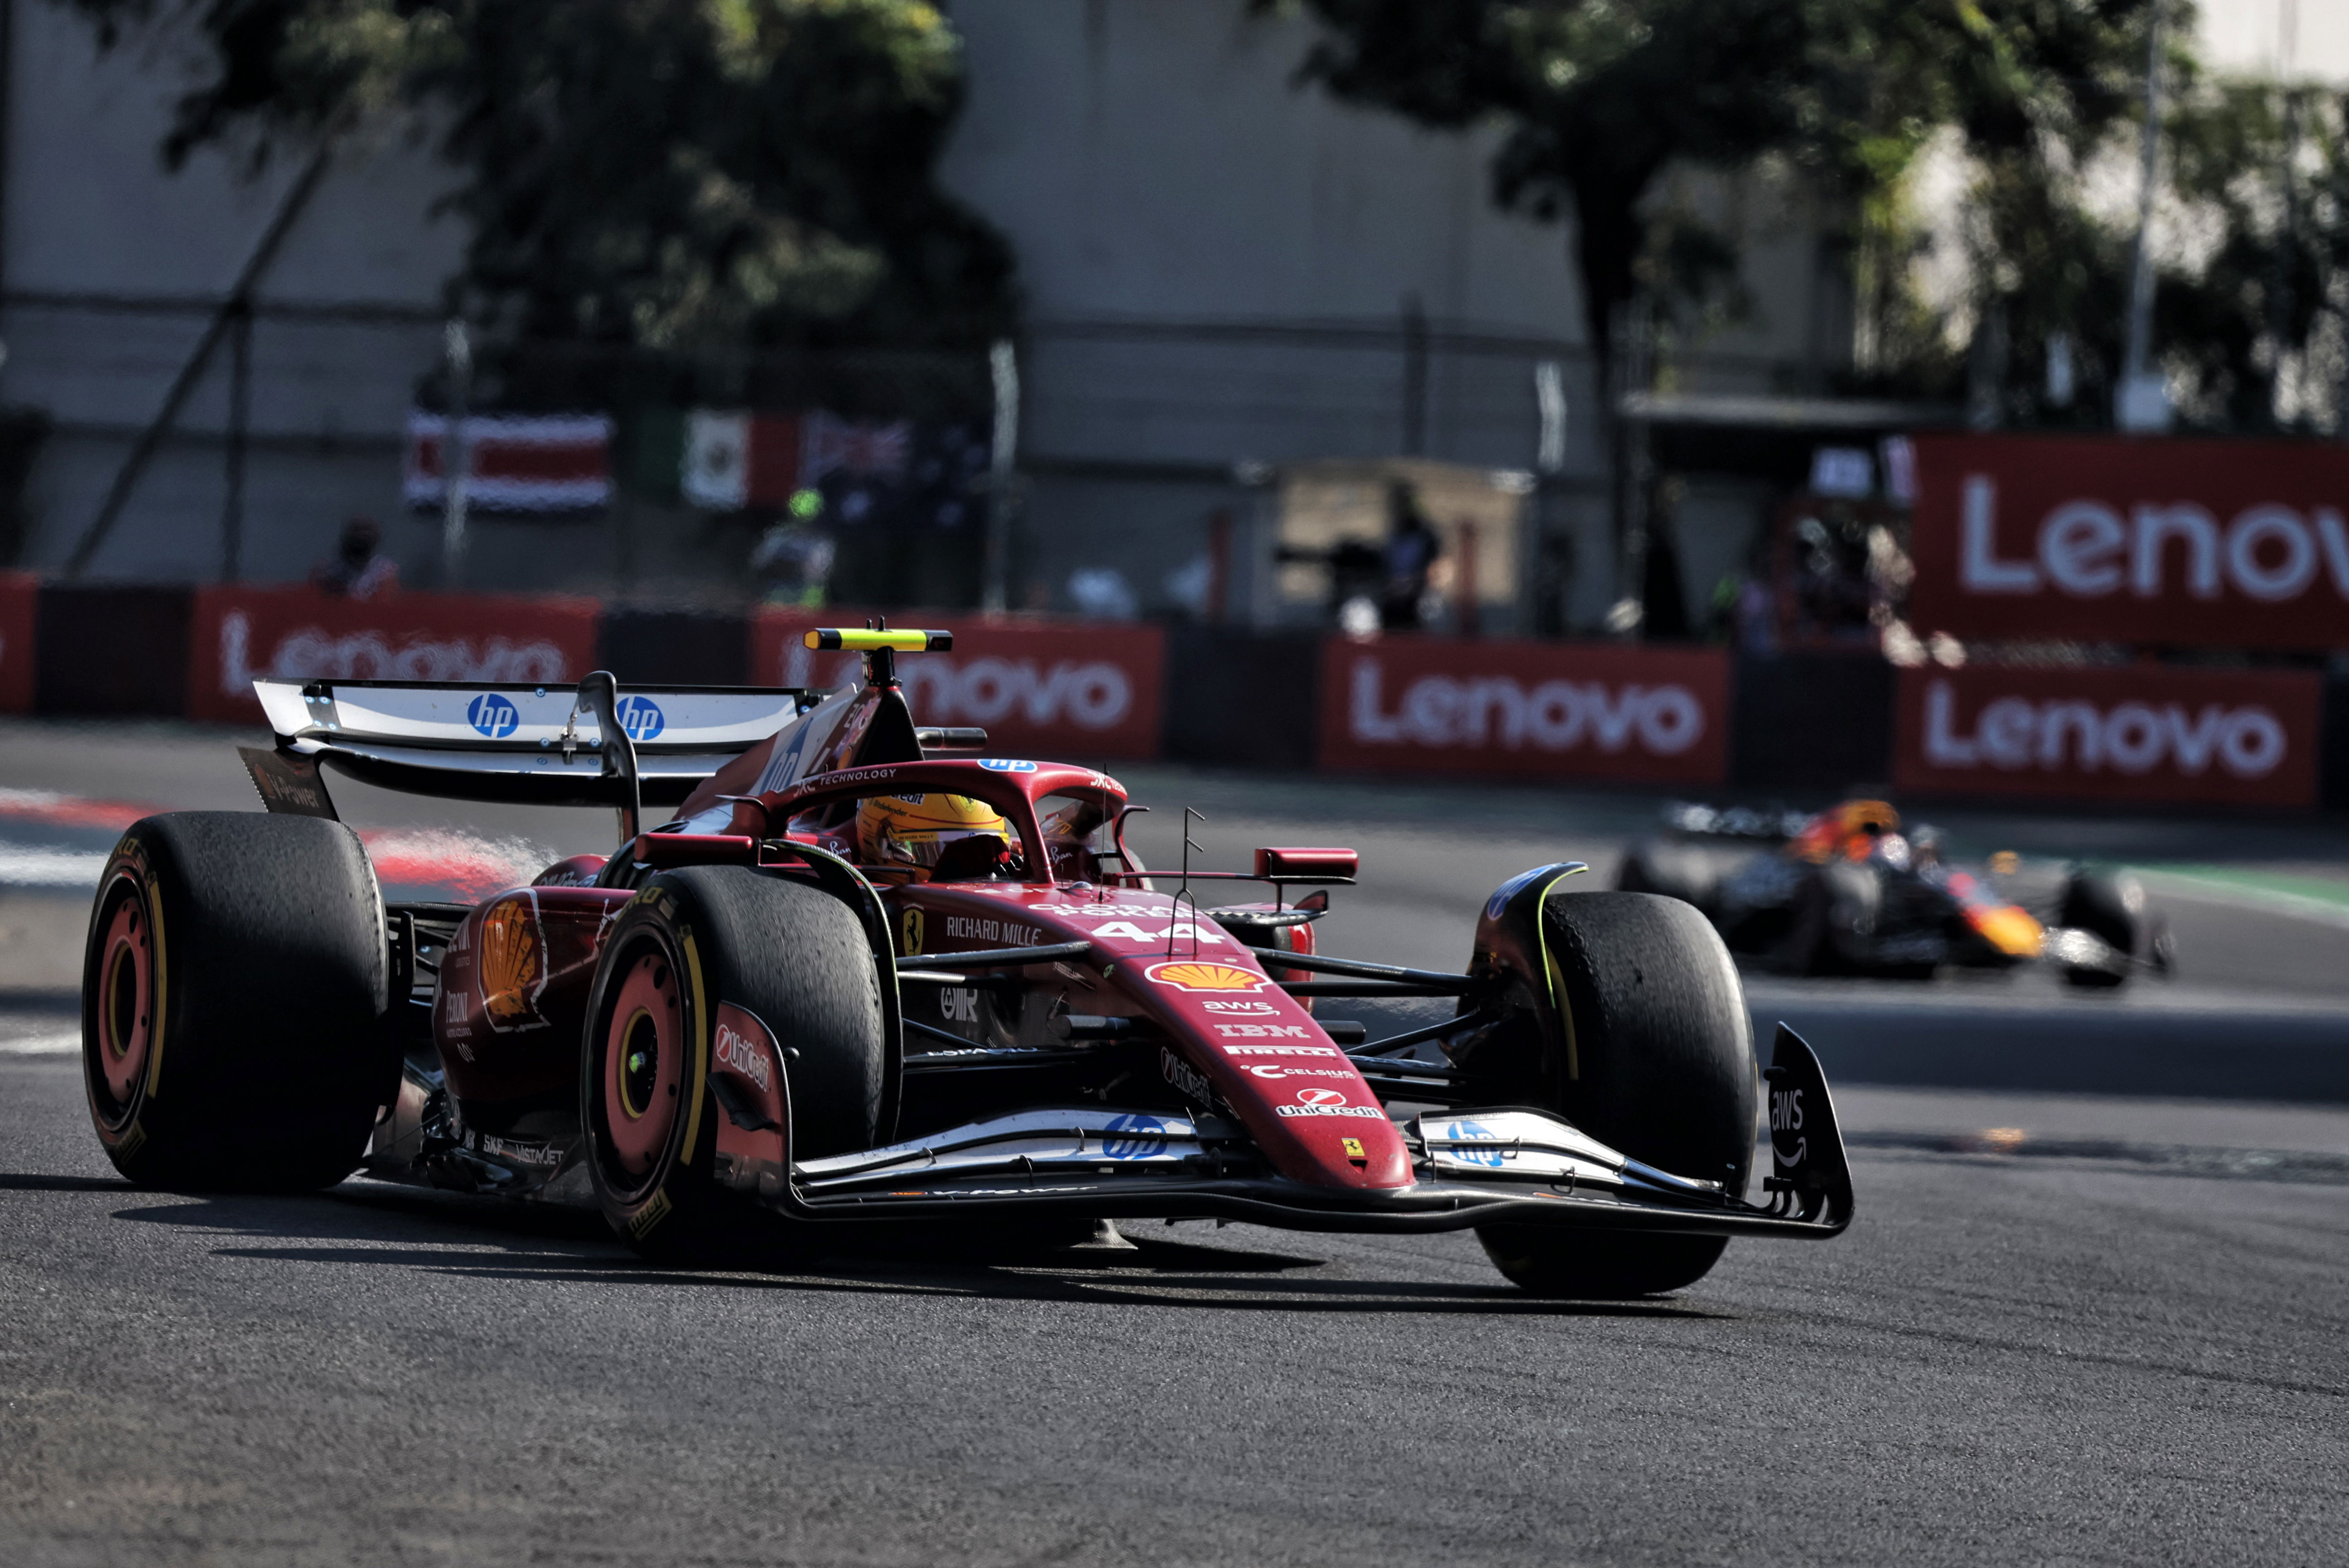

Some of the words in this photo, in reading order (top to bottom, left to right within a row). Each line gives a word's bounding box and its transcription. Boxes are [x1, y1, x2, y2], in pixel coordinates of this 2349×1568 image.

[473, 694, 516, 738] hp
[621, 696, 661, 740] hp
[1348, 655, 1706, 756] Lenovo
[1923, 680, 2287, 779] Lenovo
[820, 768, 897, 786] TECHNOLOGY
[984, 758, 1031, 772] hp
[266, 773, 319, 808] V-Power
[1027, 903, 1198, 914] GLOBAL
[1054, 909, 1201, 919] POKER
[946, 916, 999, 941] RICHARD
[1001, 922, 1042, 947] MILLE
[1090, 921, 1225, 944] 44
[1202, 1001, 1274, 1011] aws
[1213, 1024, 1312, 1038] IBM
[729, 1031, 769, 1092] UniCredit
[1223, 1045, 1337, 1057] PIRELLI
[1170, 1052, 1214, 1112] UniCredit
[1283, 1068, 1354, 1076] CELSIUS
[1275, 1105, 1385, 1120] UniCredit
[1772, 1089, 1803, 1132] aws
[483, 1133, 504, 1156] SKF
[1106, 1114, 1163, 1160] hp
[1452, 1121, 1499, 1167] hp
[628, 1186, 674, 1241] PIRELLI
